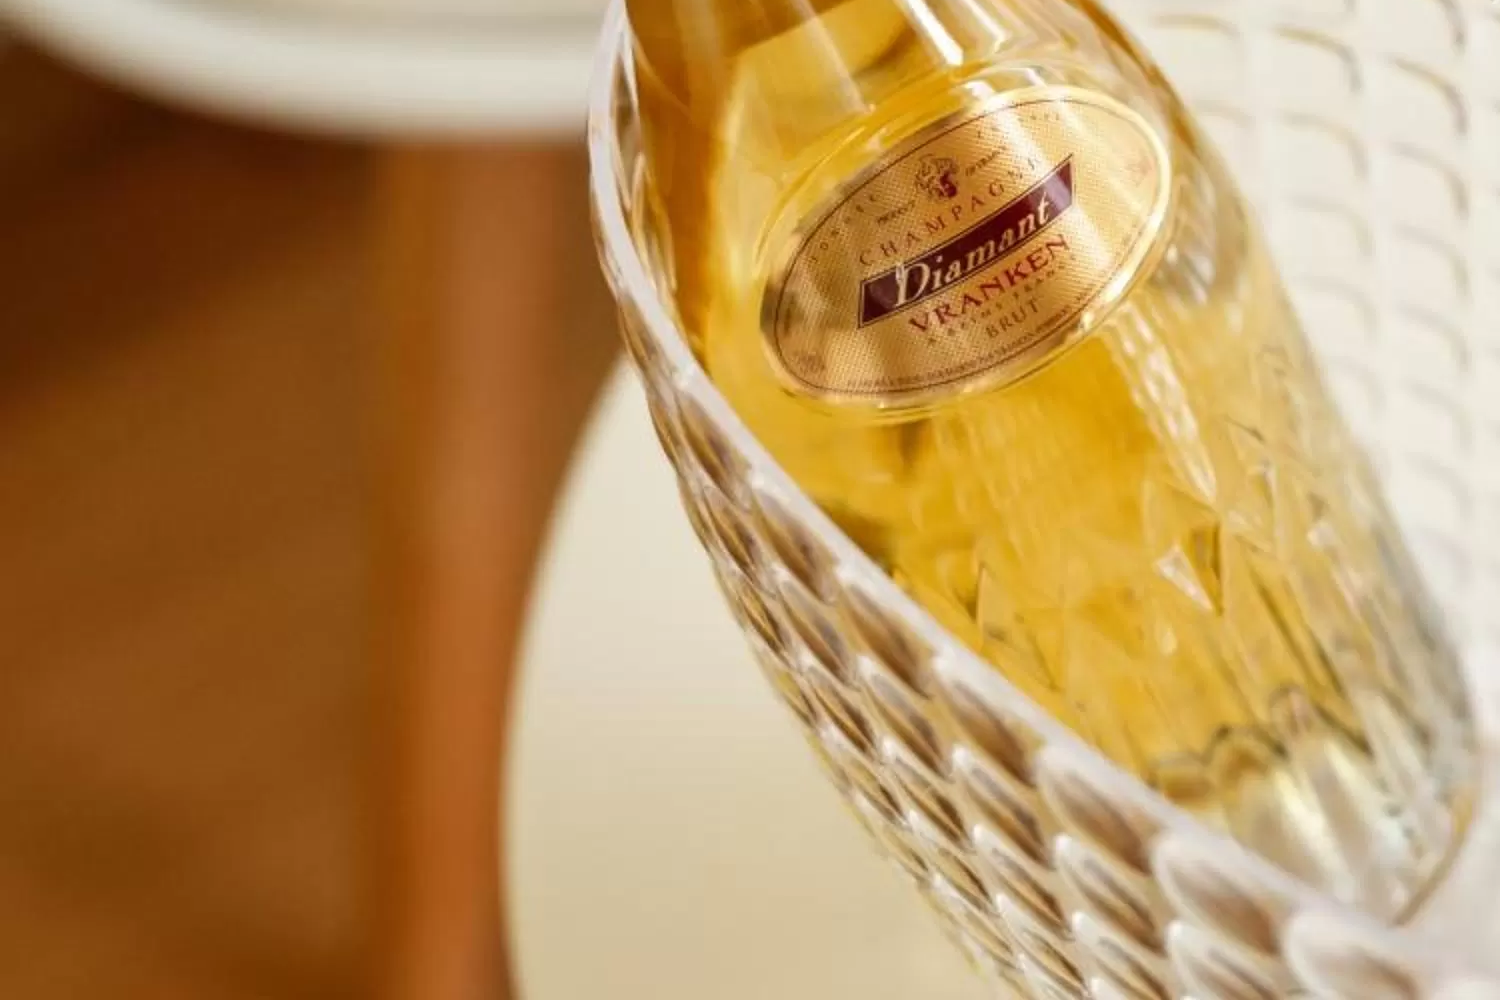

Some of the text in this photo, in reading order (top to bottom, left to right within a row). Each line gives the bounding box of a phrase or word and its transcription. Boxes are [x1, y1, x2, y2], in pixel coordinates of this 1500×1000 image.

[894, 195, 1053, 308] Diamant
[908, 233, 1070, 333] VRANKEN
[985, 299, 1040, 339] BRUT
